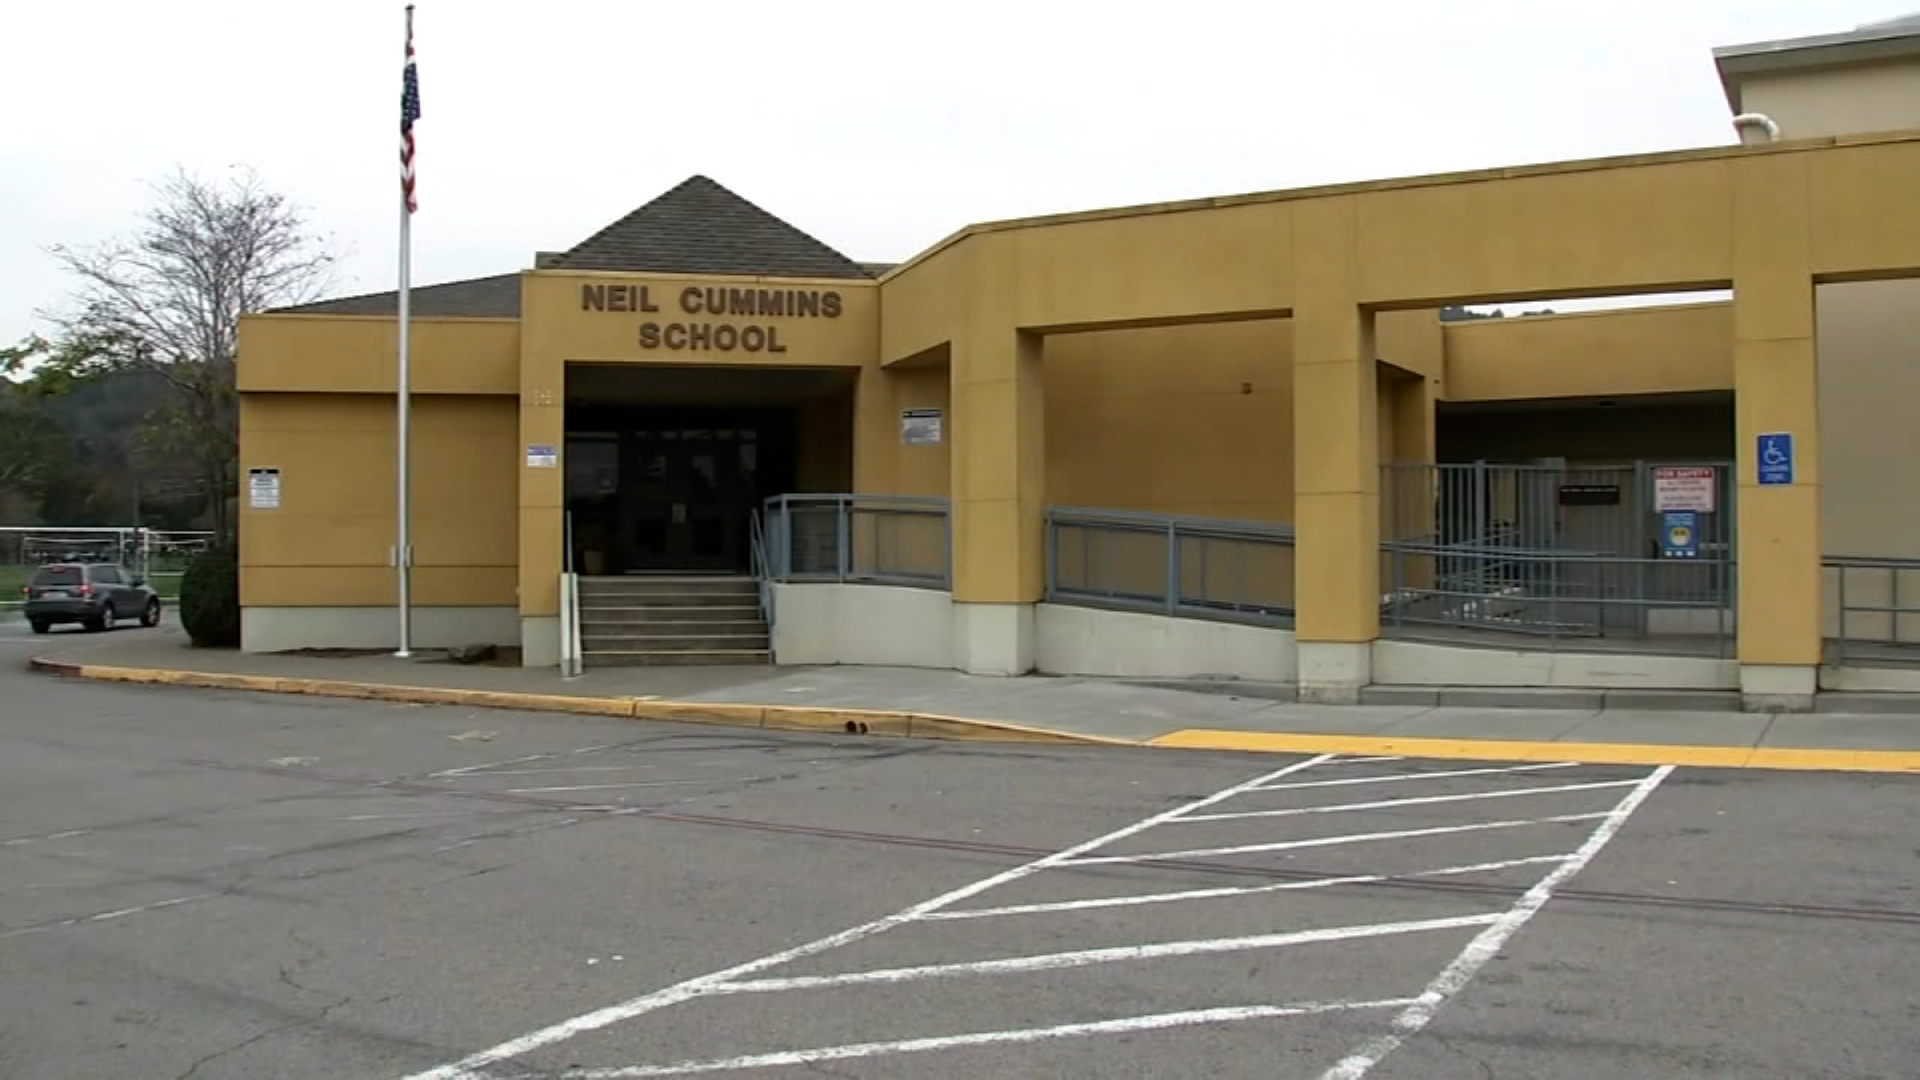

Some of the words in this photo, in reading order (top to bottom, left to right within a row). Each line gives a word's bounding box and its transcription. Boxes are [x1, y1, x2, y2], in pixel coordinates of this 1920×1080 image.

[581, 284, 659, 313] NEIL
[679, 287, 842, 318] CUMMINS
[638, 322, 787, 353] SCHOOL
